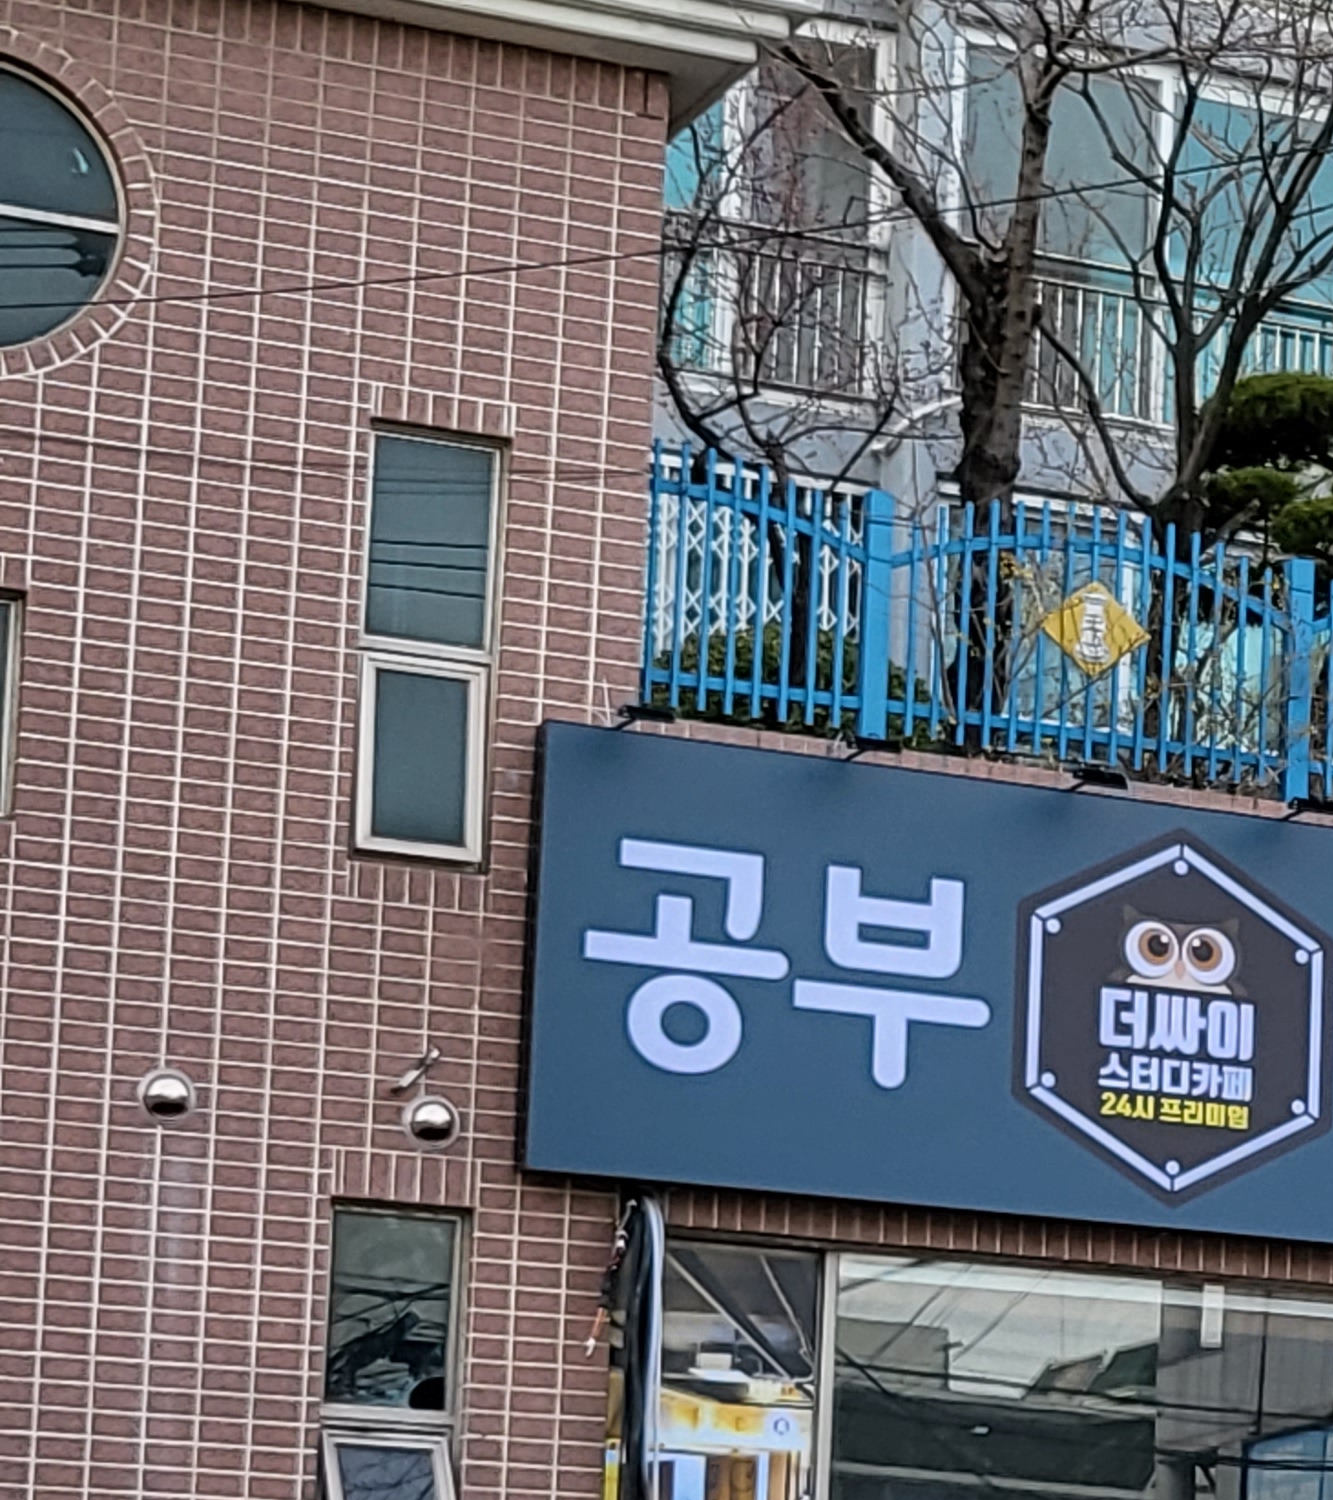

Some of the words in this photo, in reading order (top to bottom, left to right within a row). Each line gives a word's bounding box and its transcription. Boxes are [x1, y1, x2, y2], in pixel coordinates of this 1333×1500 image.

[583, 837, 991, 1091] 공부
[1100, 986, 1255, 1061] 더싸이
[1098, 1052, 1253, 1101] 스터디카페
[1101, 1091, 1155, 1120] 24시
[1159, 1097, 1249, 1130] 프리미엄
